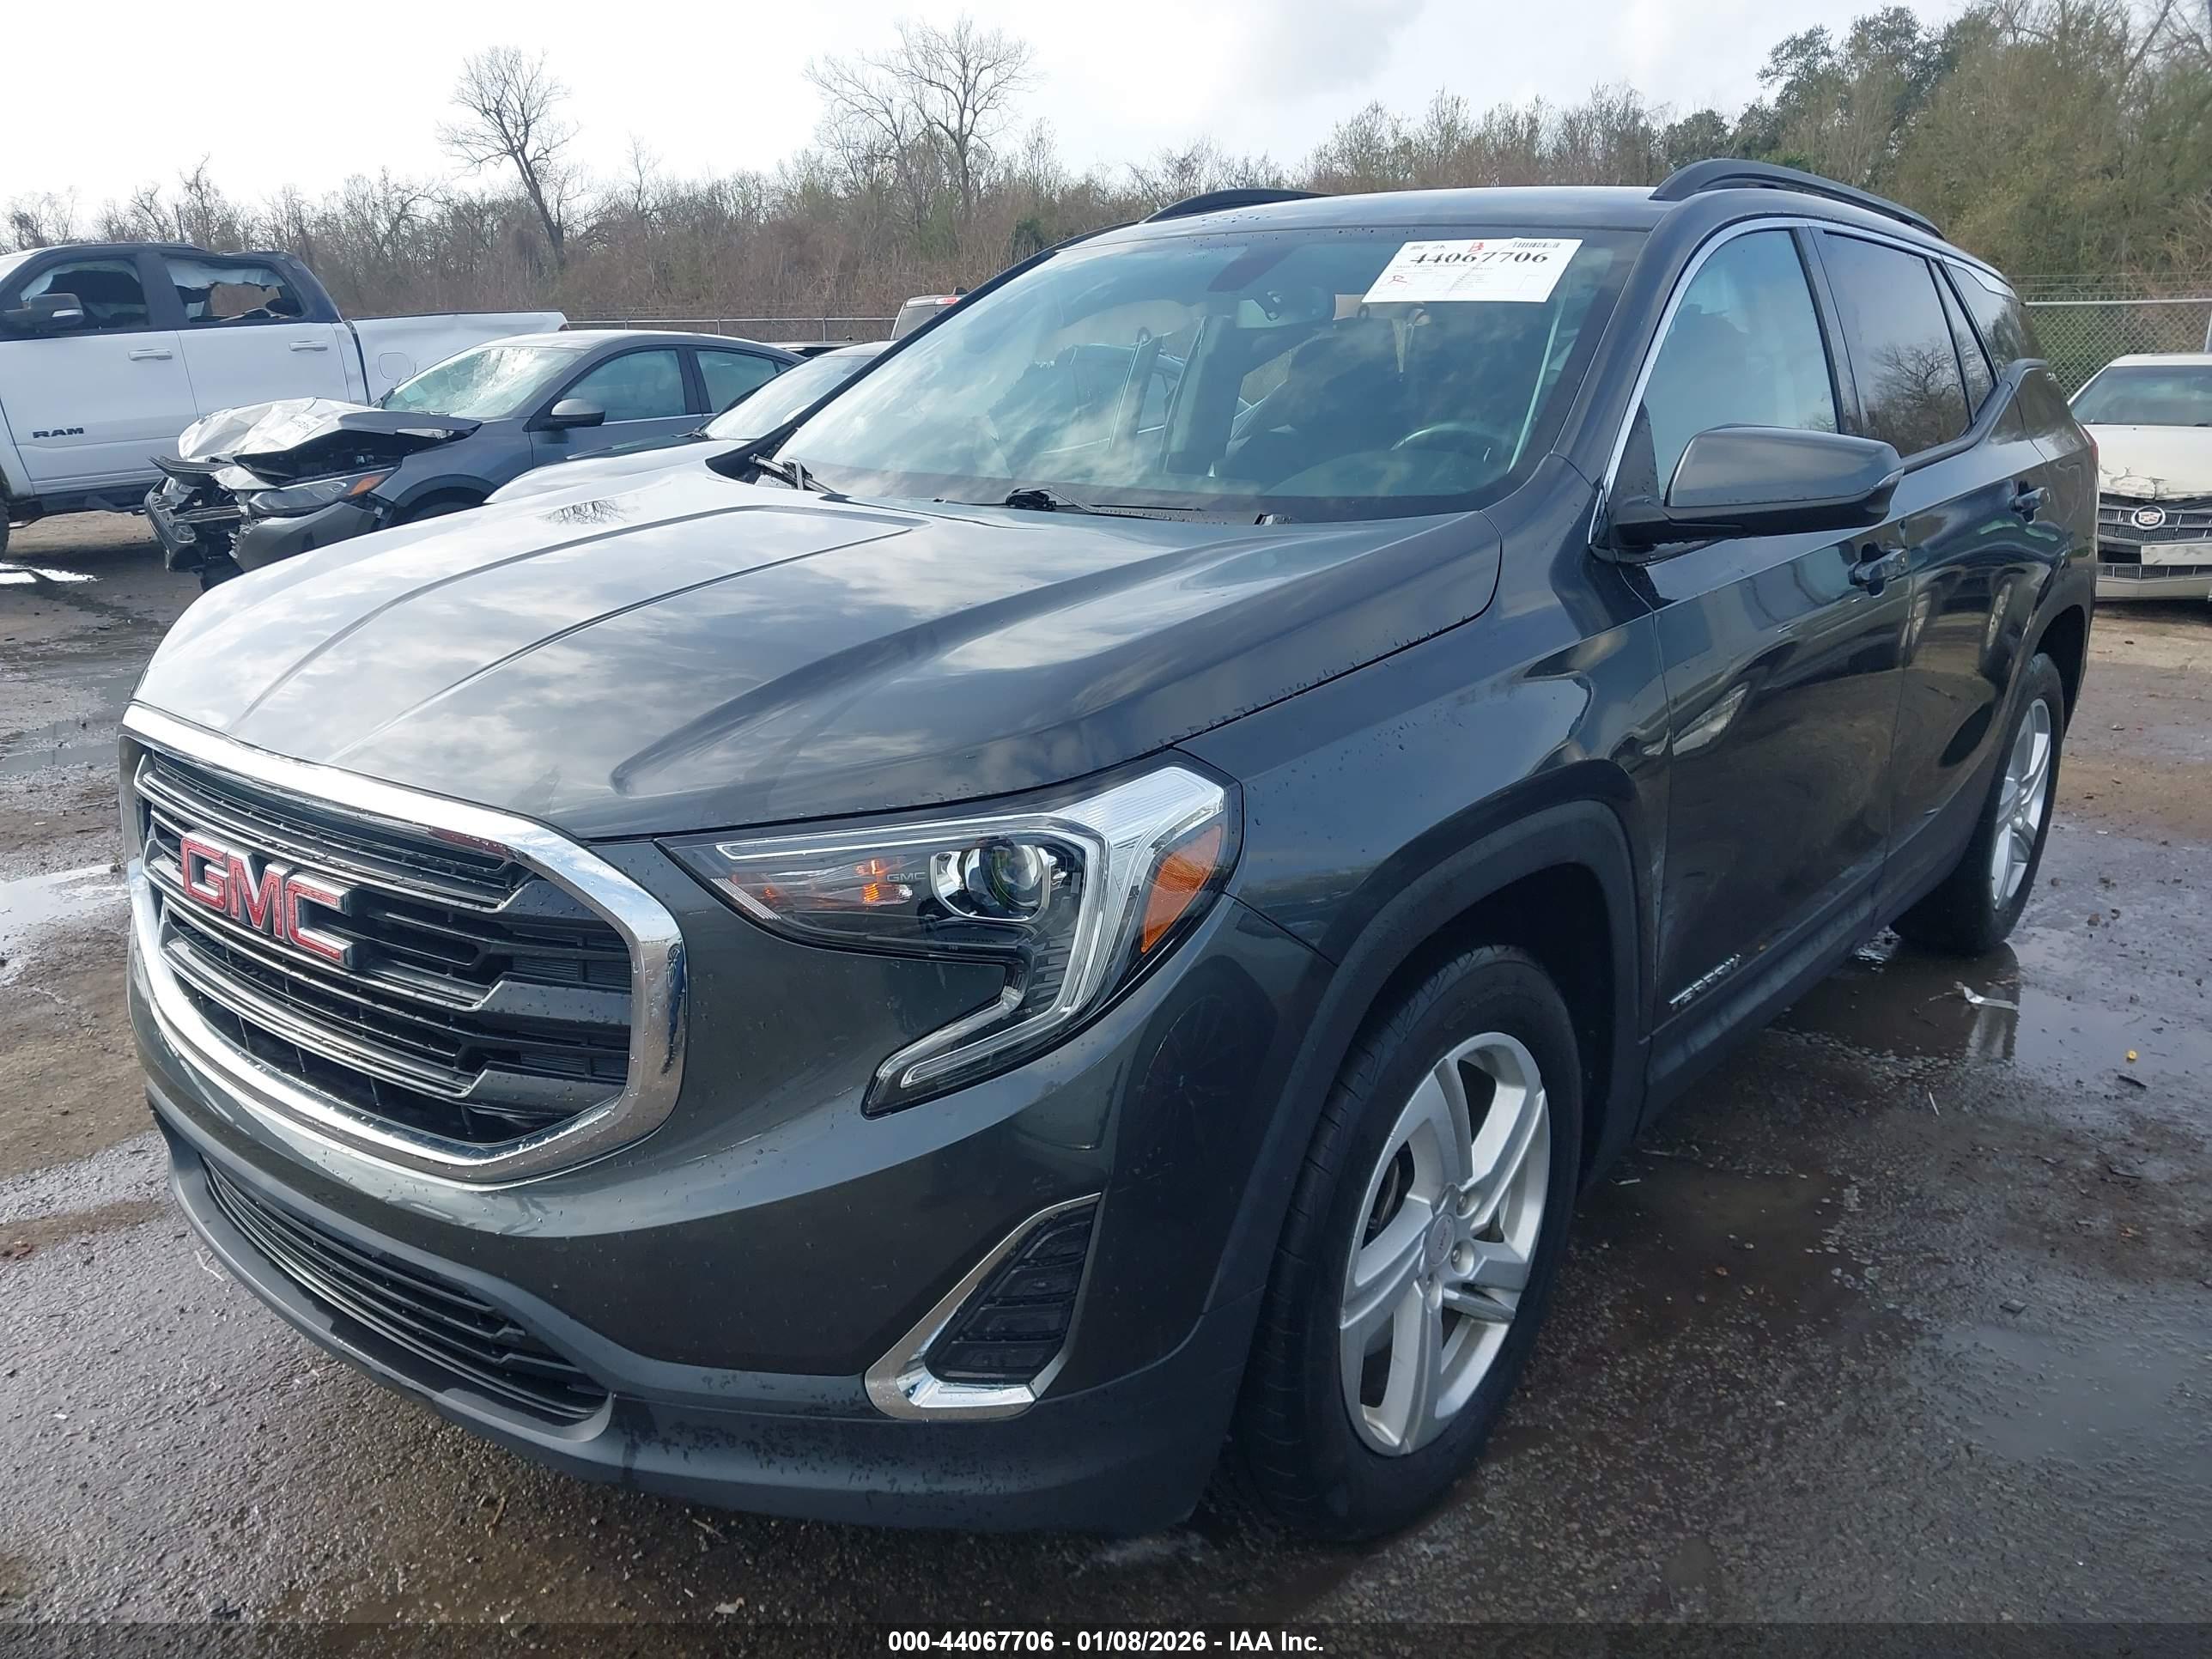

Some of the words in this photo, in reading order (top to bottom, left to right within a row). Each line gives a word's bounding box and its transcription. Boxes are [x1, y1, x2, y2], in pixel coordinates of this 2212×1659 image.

[1410, 252, 1551, 264] 44067706
[33, 427, 84, 439] RAM
[886, 872, 927, 883] GMC
[180, 830, 352, 966] GMC
